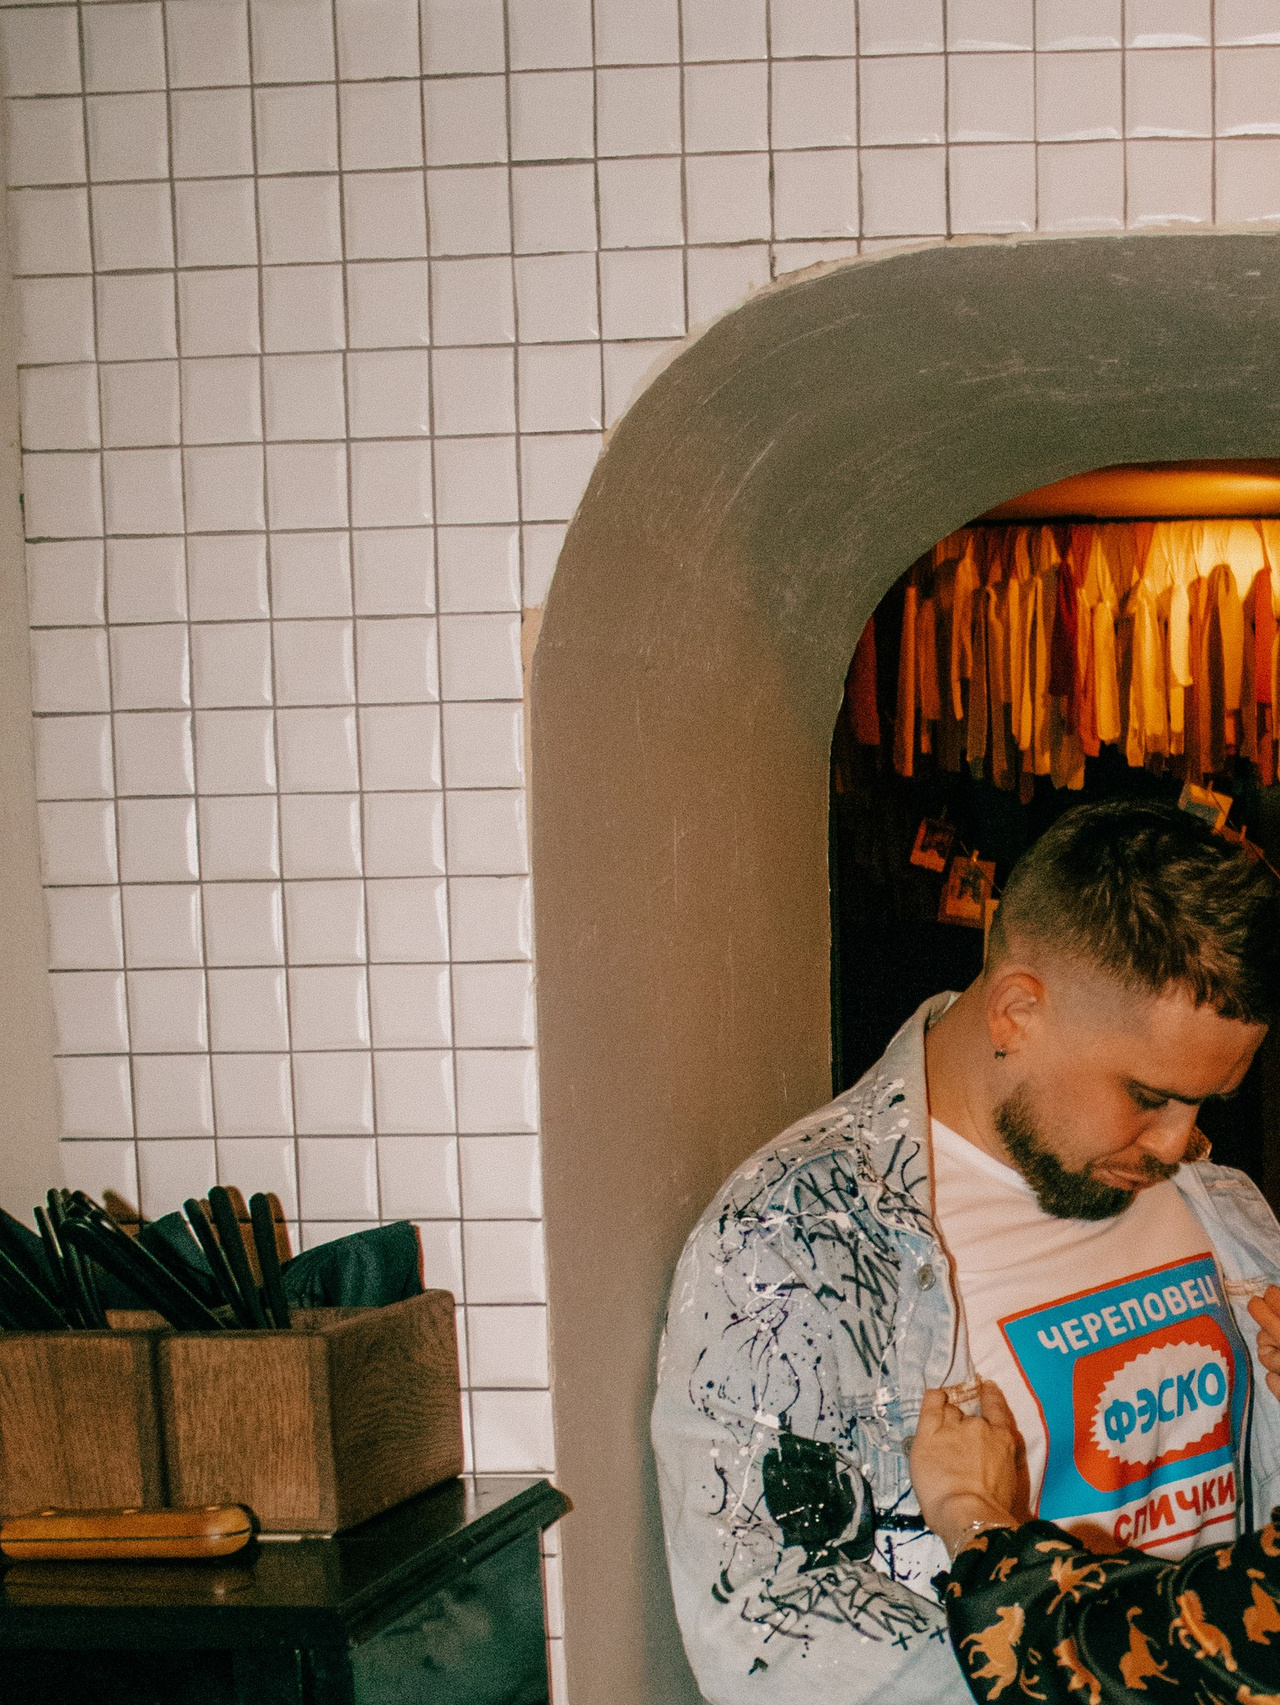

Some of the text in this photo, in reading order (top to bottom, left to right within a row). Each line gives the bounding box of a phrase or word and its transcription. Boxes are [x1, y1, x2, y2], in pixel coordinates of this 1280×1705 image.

[1037, 1275, 1221, 1354] ЧЕРЕПОВЕЦ
[1104, 1362, 1227, 1444] ФЭСКО
[1114, 1471, 1235, 1545] СПИЧКИ
